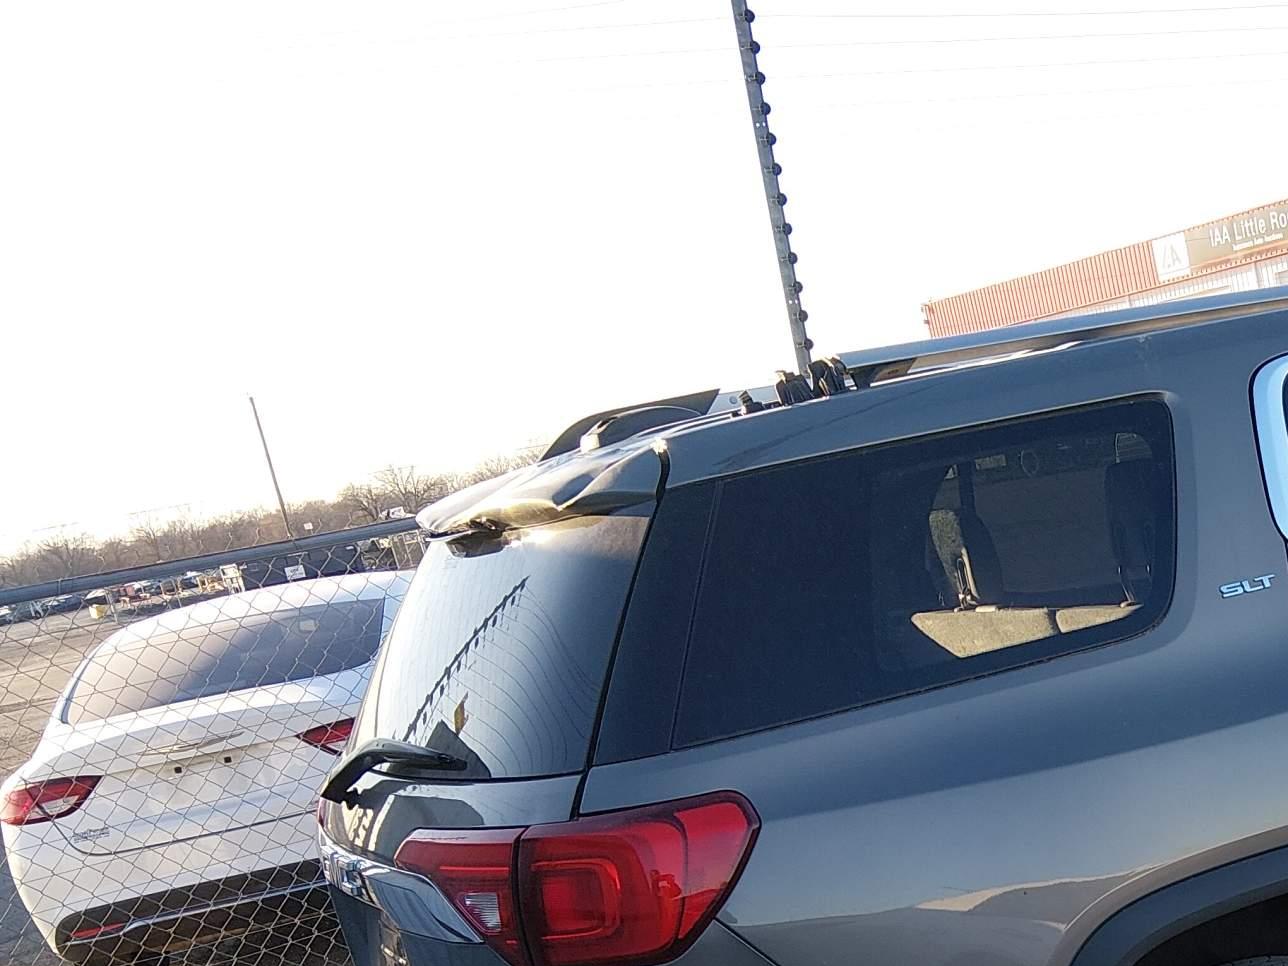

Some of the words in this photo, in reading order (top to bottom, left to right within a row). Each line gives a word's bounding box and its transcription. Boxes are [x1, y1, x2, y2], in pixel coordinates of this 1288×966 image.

[1208, 224, 1231, 247] IAA
[1232, 215, 1266, 241] Little
[1220, 574, 1276, 598] SLT
